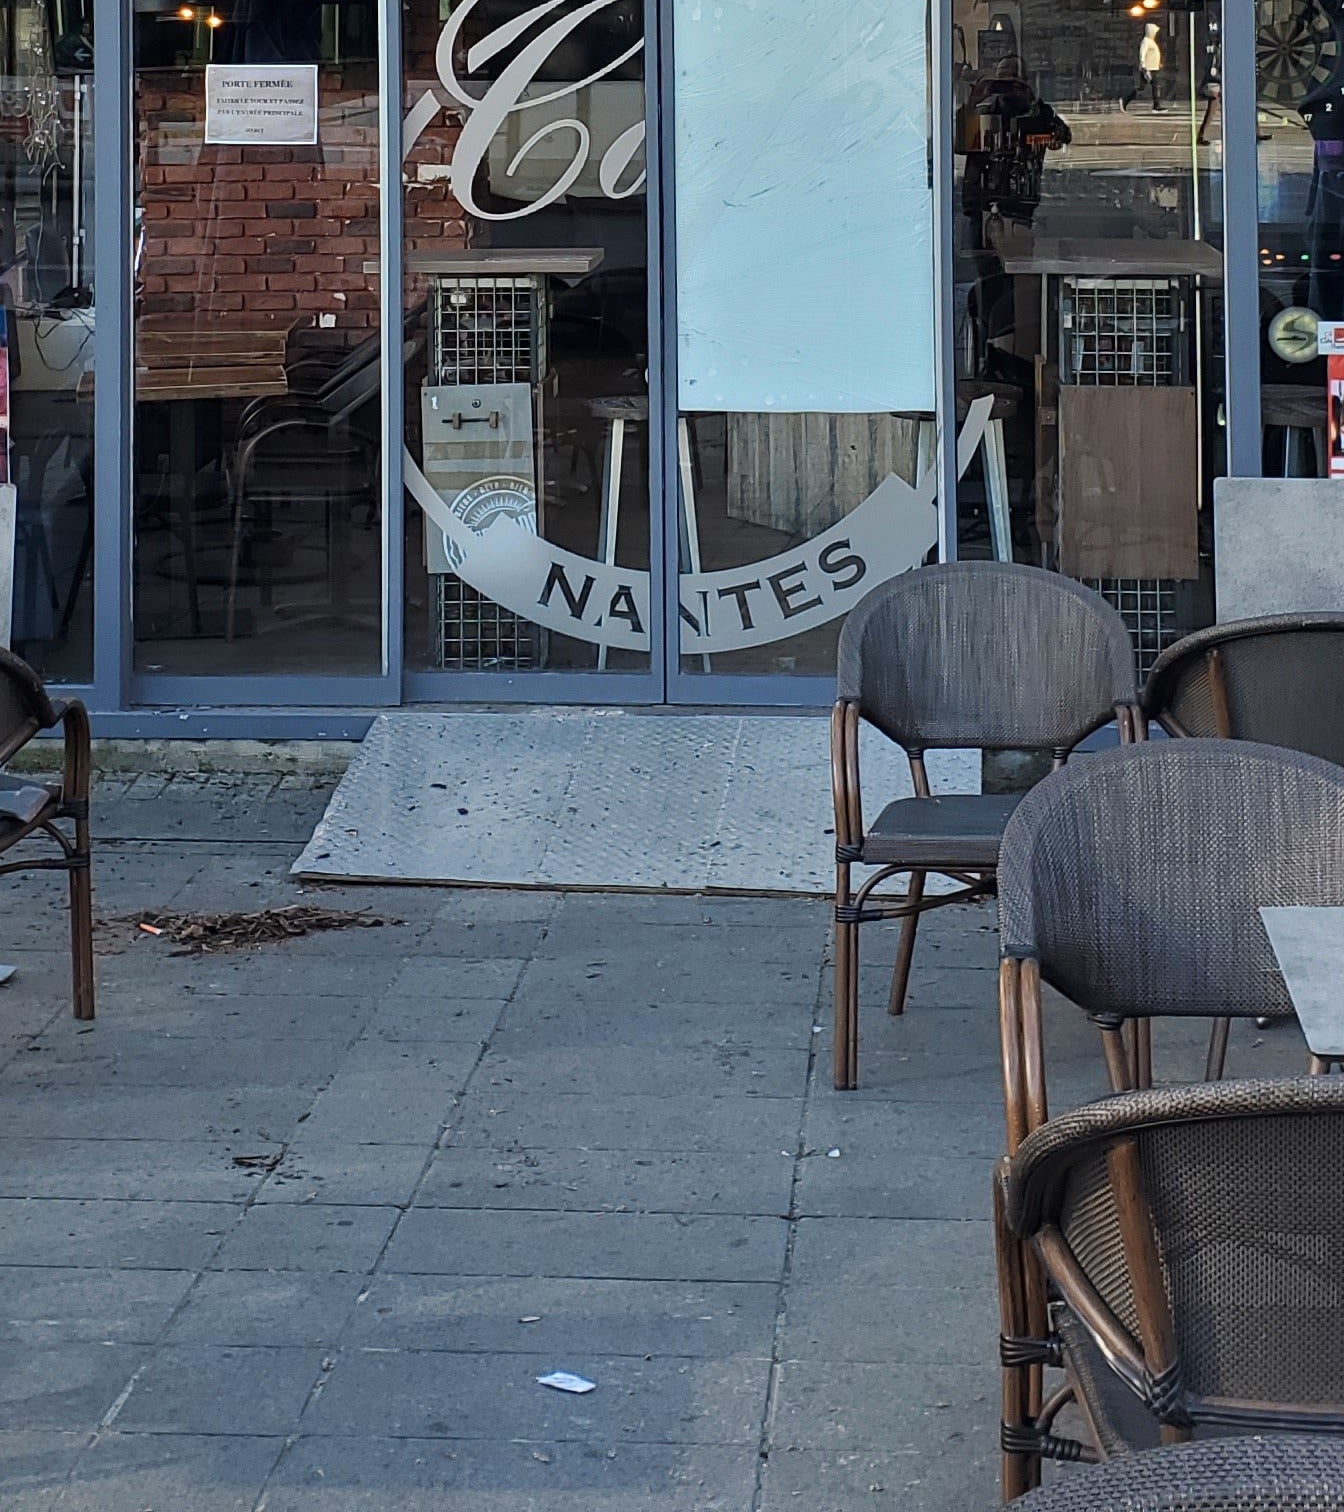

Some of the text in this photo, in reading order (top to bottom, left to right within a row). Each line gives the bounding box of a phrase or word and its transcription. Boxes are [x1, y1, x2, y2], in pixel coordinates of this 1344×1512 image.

[221, 80, 252, 89] PORTE
[216, 97, 305, 105] FAITES LE TOUR ET PASSEZ
[1325, 103, 1333, 112] 2
[263, 109, 304, 117] PRINCIPALE
[536, 536, 867, 638] NANTES
